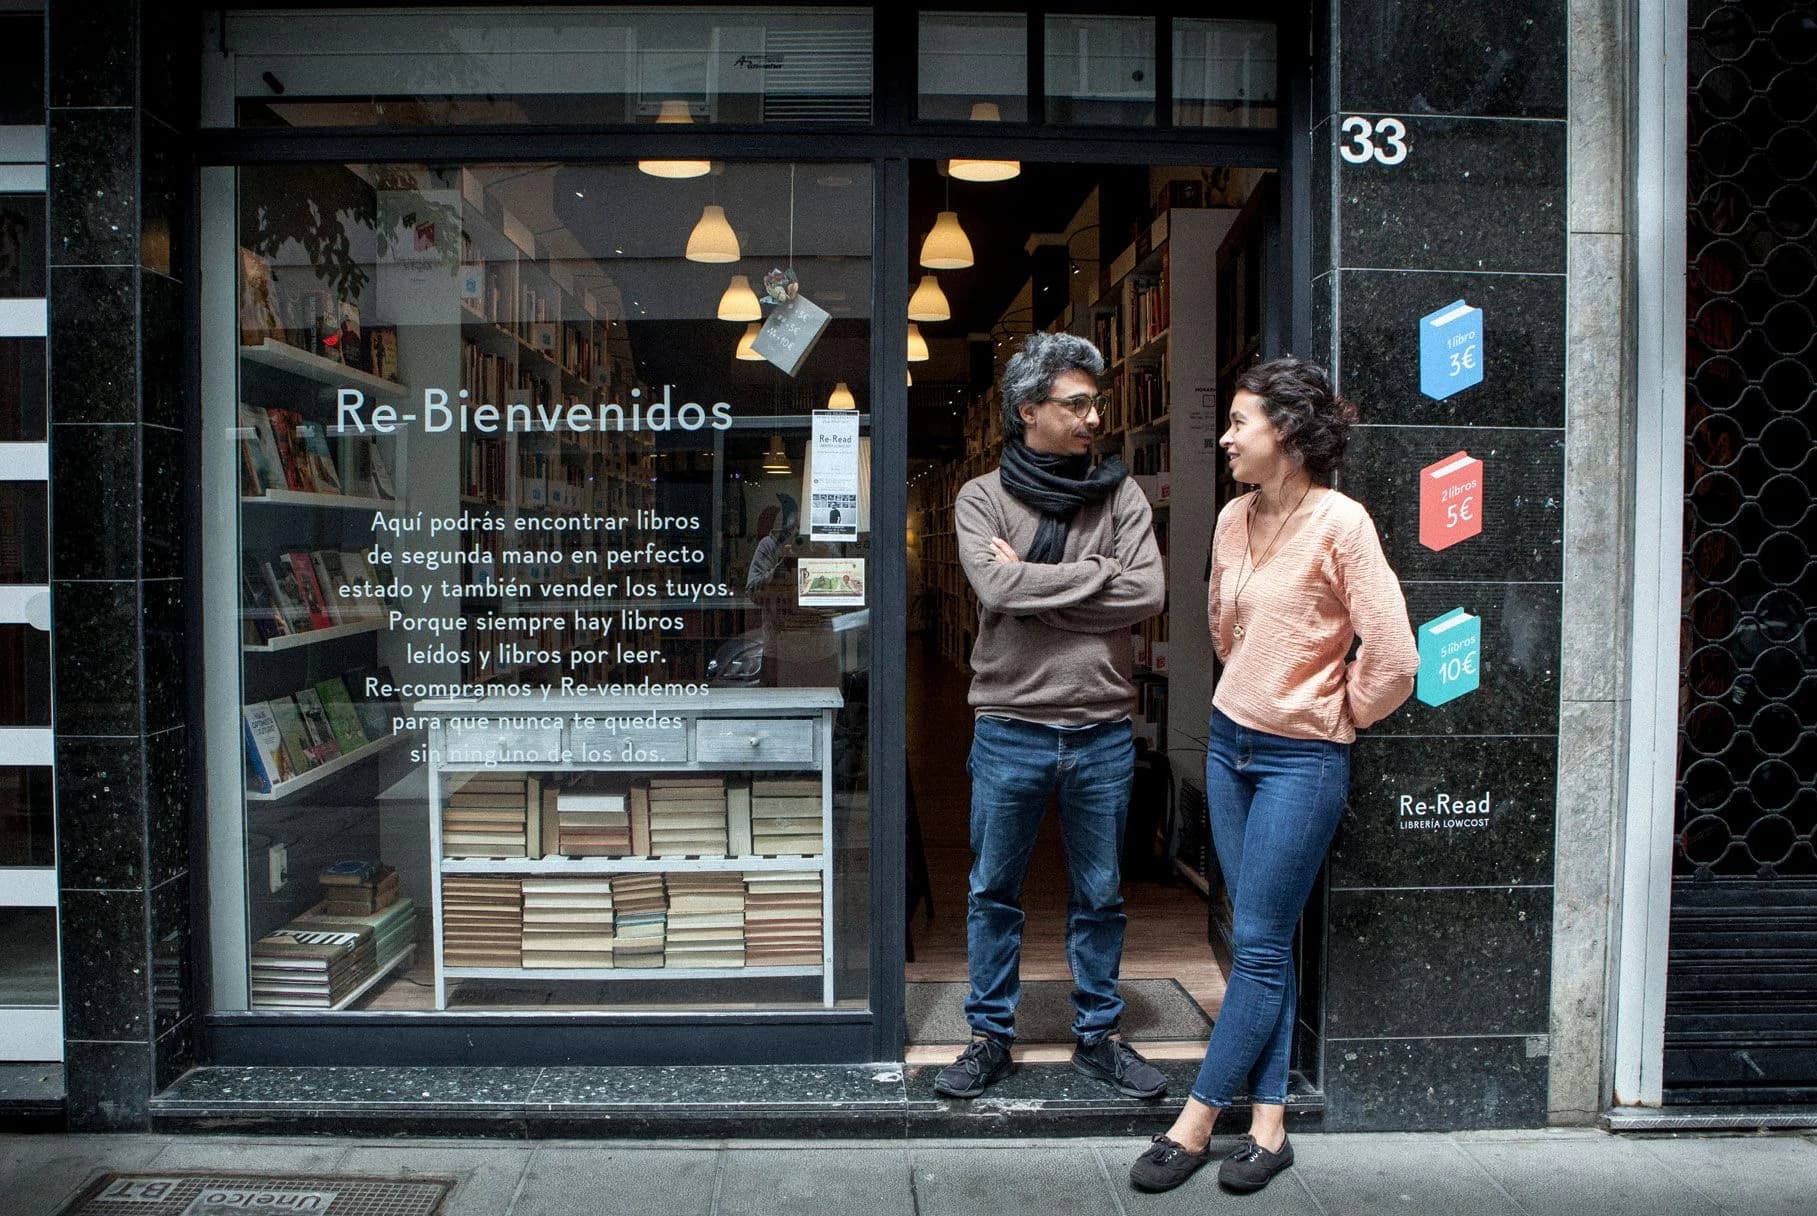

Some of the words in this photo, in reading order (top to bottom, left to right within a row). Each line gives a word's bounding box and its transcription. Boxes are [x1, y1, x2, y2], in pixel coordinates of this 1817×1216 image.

[1340, 116, 1407, 165] 33
[1449, 345, 1476, 377] 3€
[337, 385, 733, 433] Re-Bienvenidos
[371, 511, 422, 537] Aquí
[431, 511, 506, 537] podrás
[514, 514, 630, 531] encontrar
[637, 509, 700, 530] libros
[1446, 496, 1473, 528] 5€
[367, 545, 393, 564] de
[401, 544, 493, 570] segunda
[503, 550, 563, 564] mano
[571, 550, 597, 564] en
[607, 543, 705, 570] perfecto
[338, 577, 414, 597] estado
[421, 584, 433, 604] y
[441, 576, 531, 597] también
[540, 576, 618, 597] vender
[626, 576, 657, 597] los
[666, 579, 735, 604] tuyos.
[389, 611, 468, 636] Porque
[477, 611, 566, 636] siempre
[575, 609, 613, 636] hay
[621, 609, 685, 630] libros
[407, 642, 471, 663] leídos
[479, 650, 491, 670] y
[499, 642, 562, 663] libros
[570, 649, 609, 669] por
[616, 642, 667, 663] leer.
[1439, 650, 1477, 685] 10€
[365, 677, 532, 701] Re-compramos
[540, 683, 552, 702] y
[561, 675, 710, 697] Re-vendemos
[392, 716, 441, 736] para
[450, 716, 489, 736] que
[498, 716, 564, 730] nunca
[573, 712, 596, 730] te
[604, 709, 683, 736] quedes
[410, 743, 441, 763] sin
[450, 744, 539, 767] ninguno
[547, 742, 573, 762] de
[582, 742, 612, 762] los
[621, 742, 666, 762] dos.
[1400, 791, 1490, 816] Re-Read
[1400, 818, 1440, 830] LIBRERÍA
[1443, 818, 1490, 828] LOWCOST
[104, 1181, 172, 1198] BT
[206, 1191, 323, 1210] Unelco
